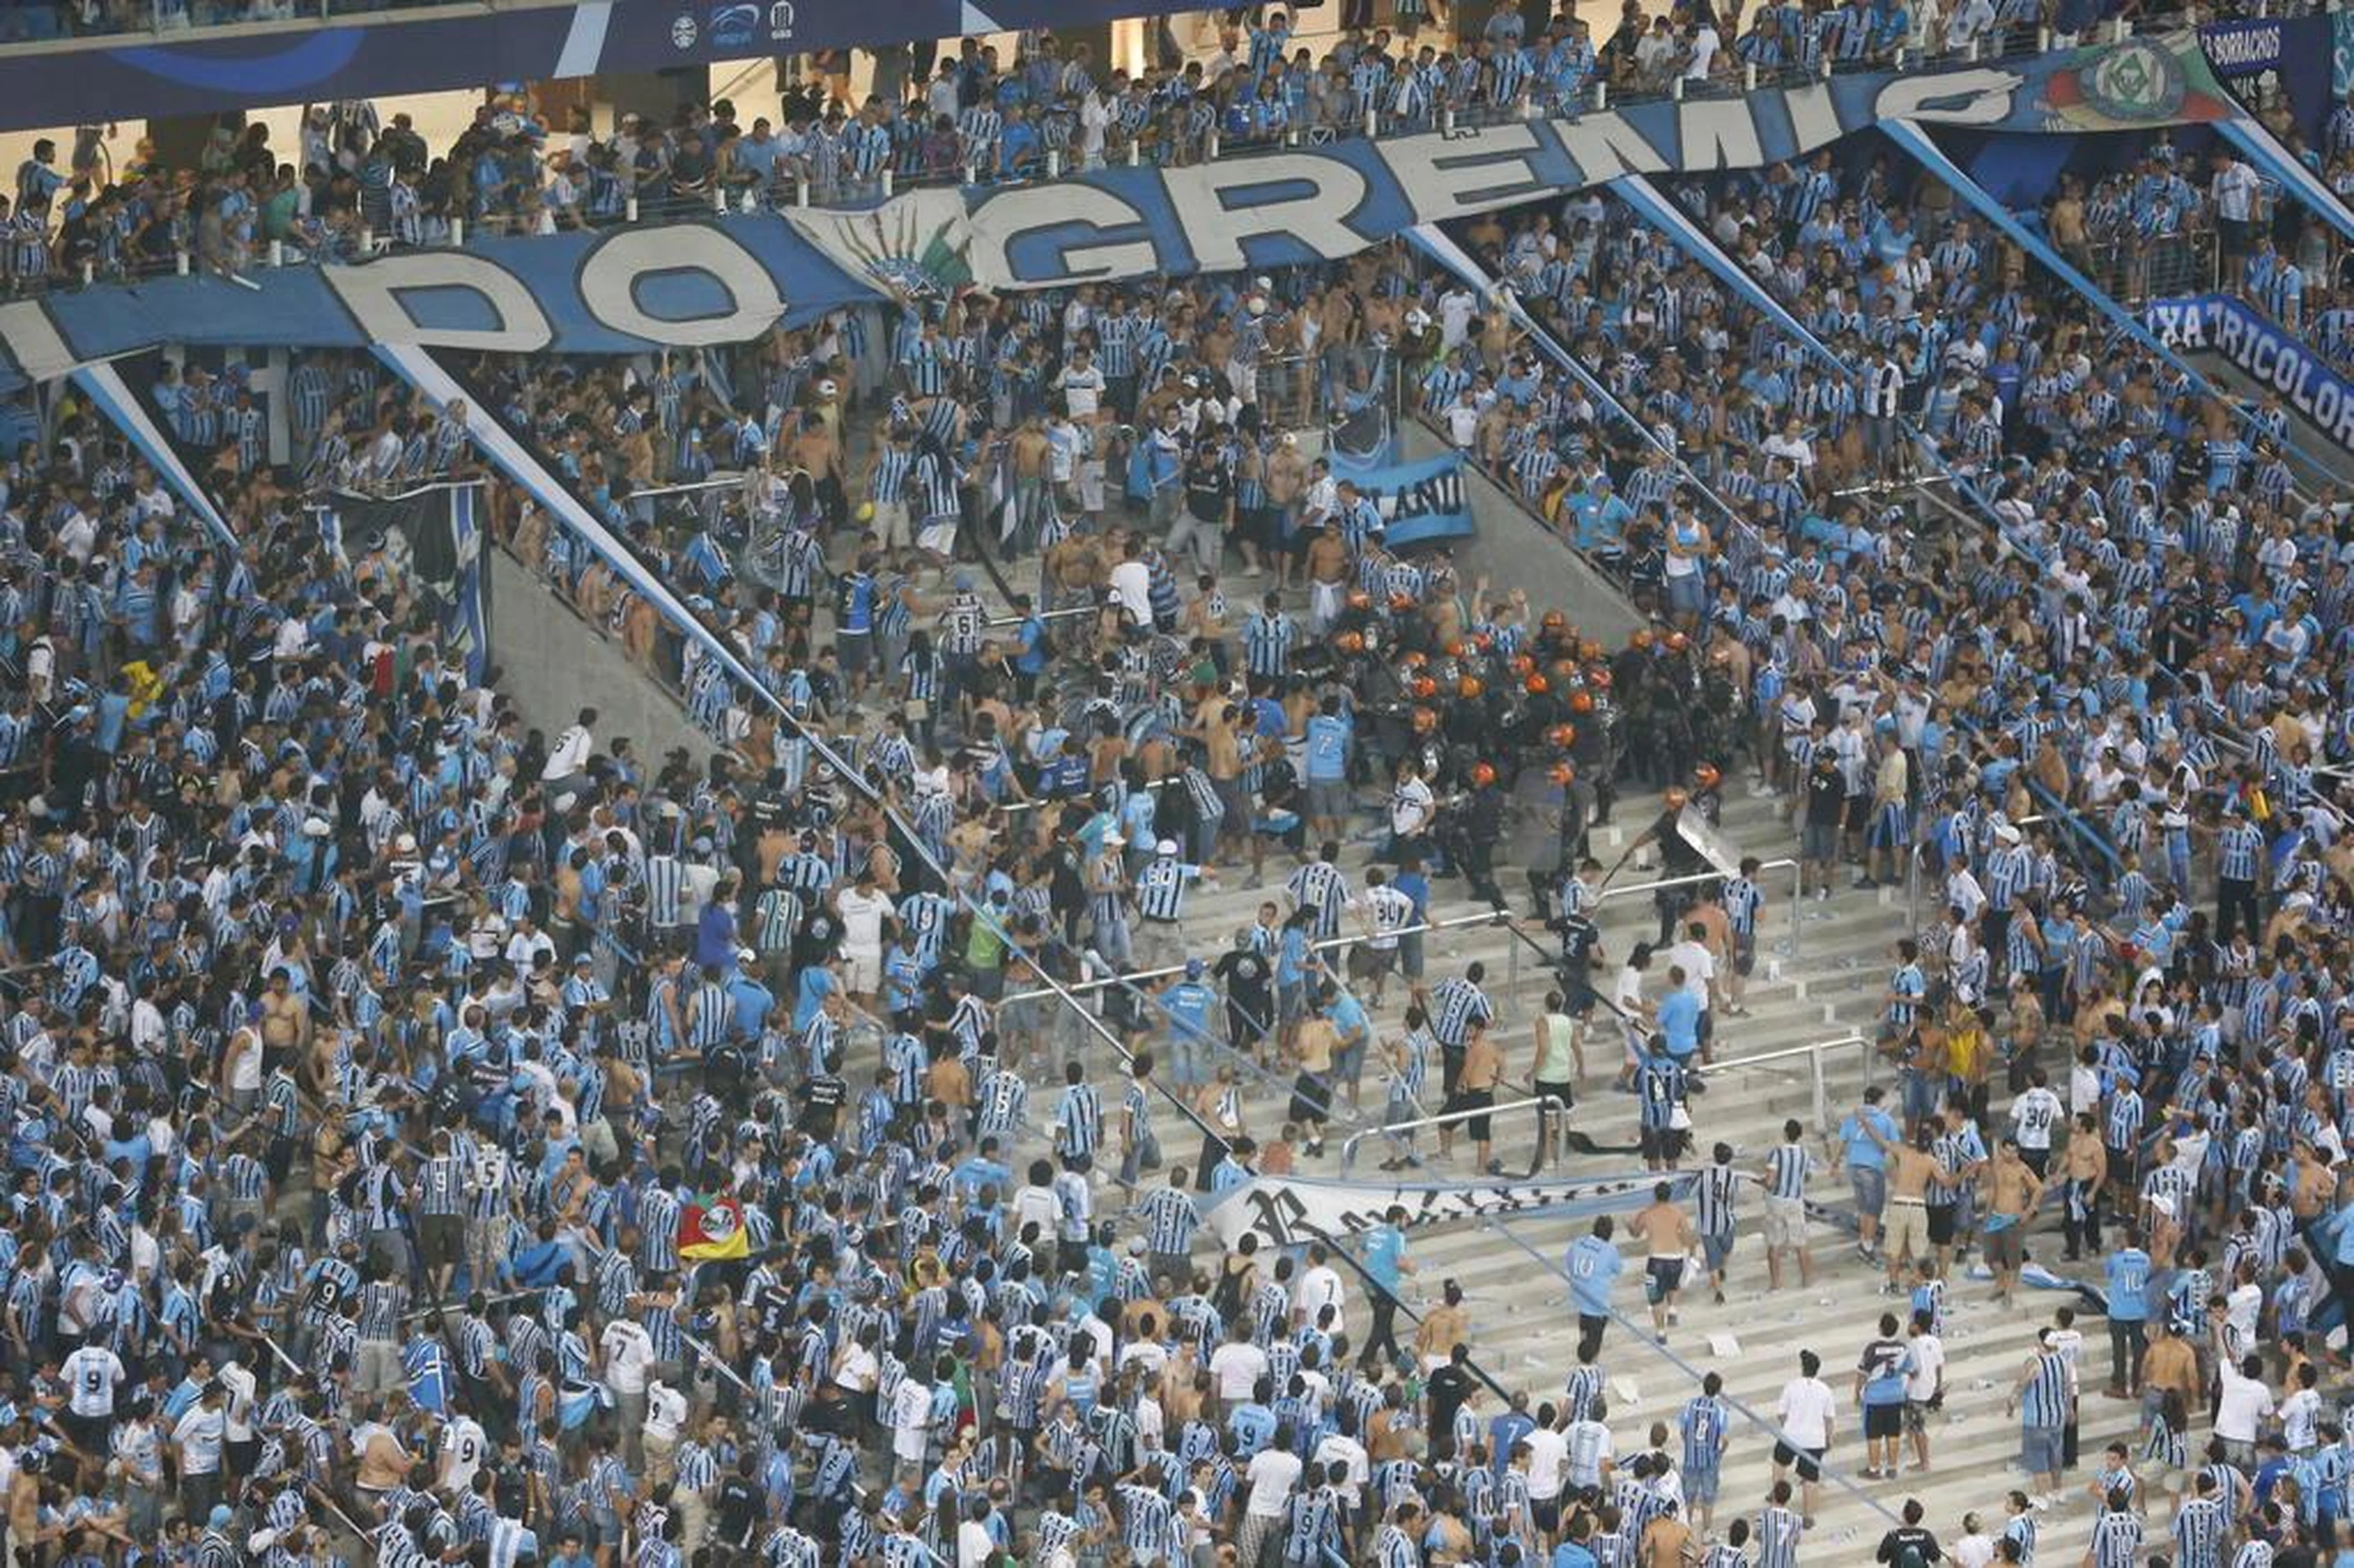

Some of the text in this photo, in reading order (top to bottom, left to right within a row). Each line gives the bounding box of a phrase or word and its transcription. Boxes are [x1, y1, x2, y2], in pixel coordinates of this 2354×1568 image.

[321, 224, 788, 352] DO
[958, 615, 970, 633] 6
[1377, 900, 1396, 922] 30
[625, 1040, 643, 1060] 10
[997, 1095, 1008, 1113] 5
[2025, 1108, 2049, 1130] 30
[436, 1172, 447, 1192] 9
[484, 1161, 497, 1186] 5
[1574, 1256, 1594, 1277] 10
[322, 1284, 335, 1304] 9
[1323, 1279, 1335, 1301] 7
[615, 1340, 627, 1361] 7
[86, 1371, 101, 1391] 9
[651, 1402, 661, 1420] 9
[1241, 1425, 1255, 1447] 9
[1507, 1421, 1519, 1445] 7
[461, 1437, 474, 1463] 9
[1073, 1456, 1085, 1479] 9
[1300, 1514, 1313, 1536] 9
